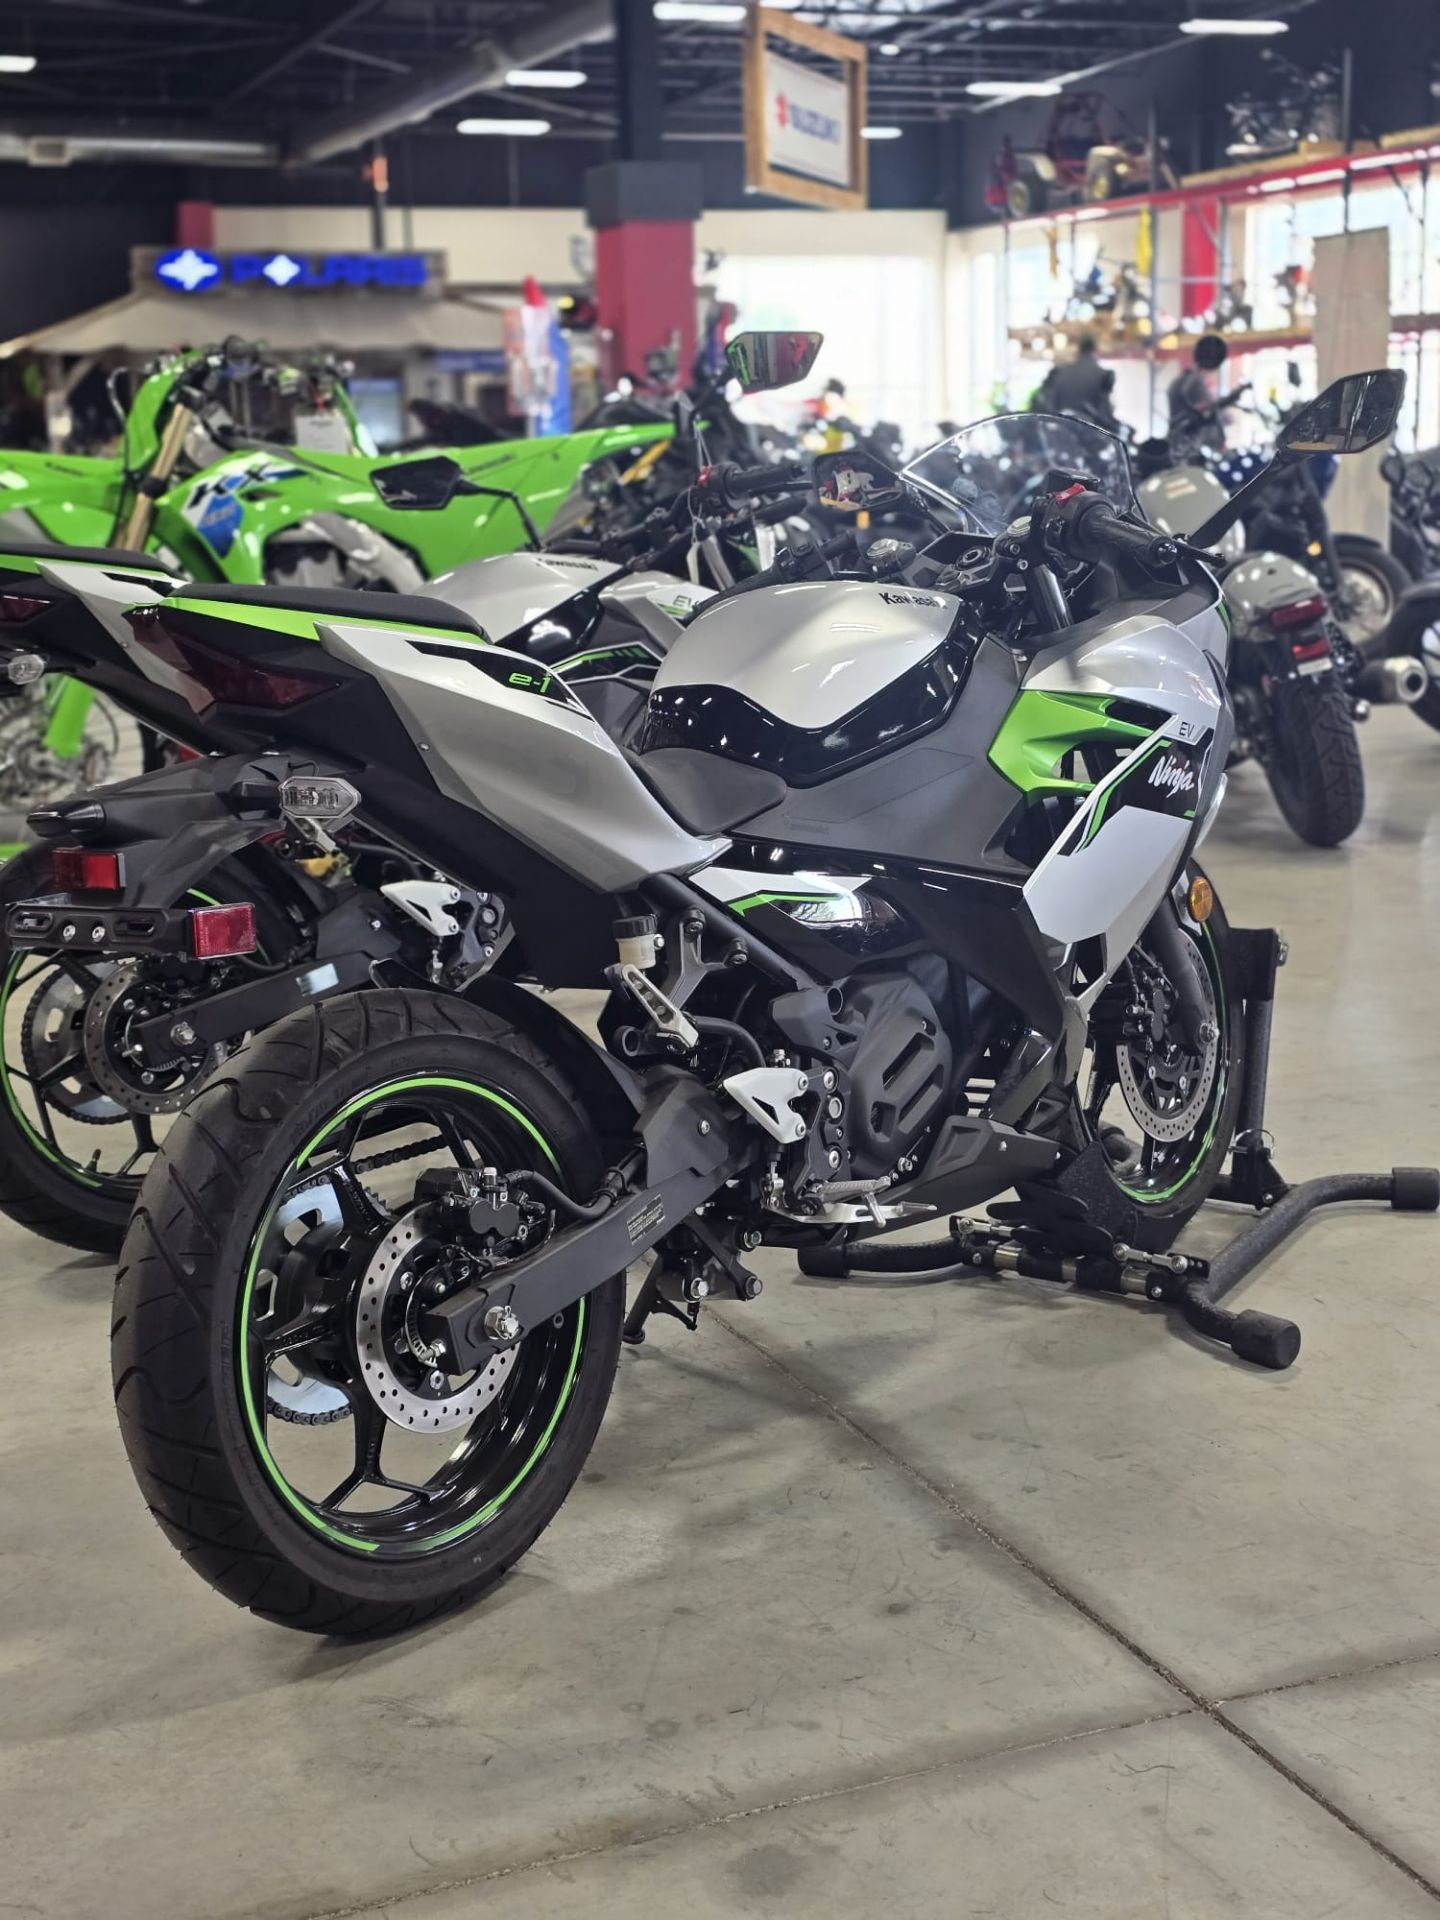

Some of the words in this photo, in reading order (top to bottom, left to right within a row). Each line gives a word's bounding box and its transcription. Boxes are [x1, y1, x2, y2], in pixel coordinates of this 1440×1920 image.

[879, 592, 948, 609] Kawasa
[508, 672, 551, 693] e-1
[1178, 721, 1195, 738] EV
[1148, 755, 1195, 799] Ninja
